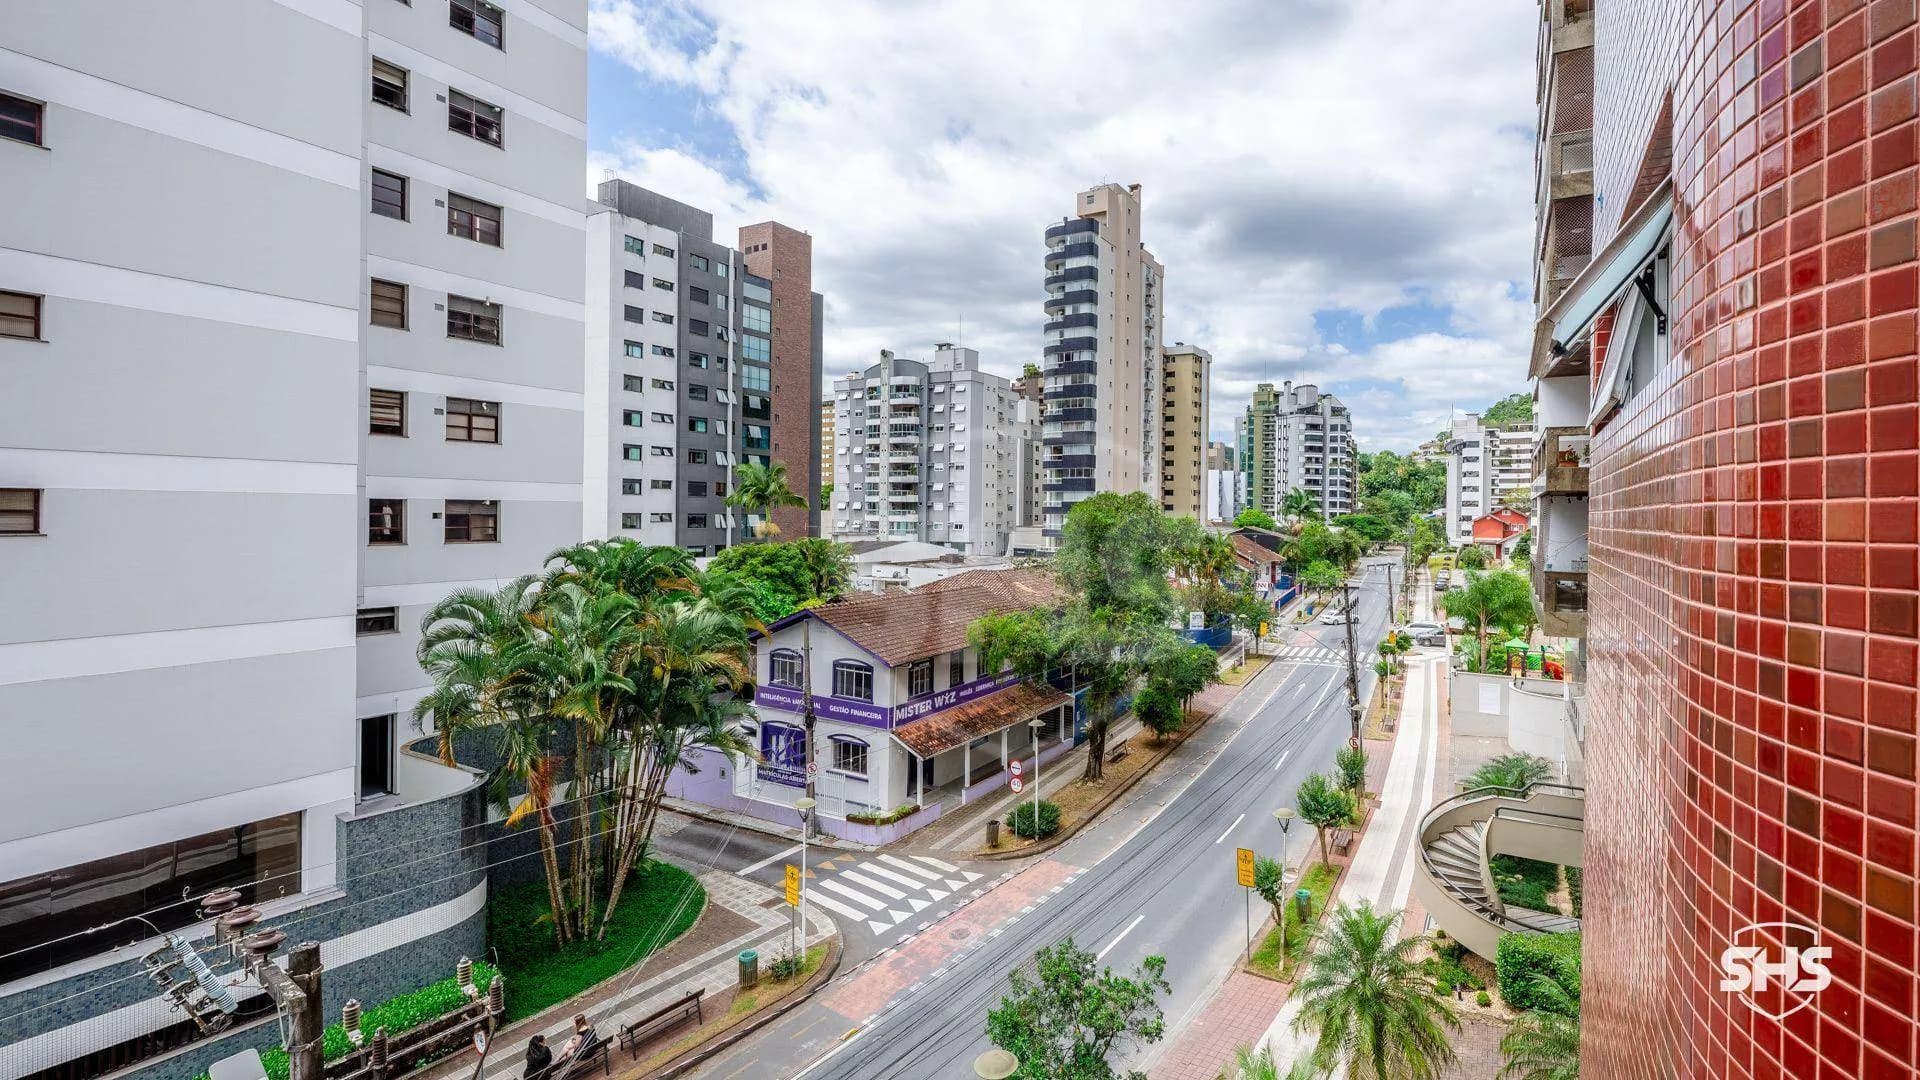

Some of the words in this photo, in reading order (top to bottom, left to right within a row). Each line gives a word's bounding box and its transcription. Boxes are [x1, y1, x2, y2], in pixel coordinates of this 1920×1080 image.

[760, 692, 791, 704] INTELIGÊNCIA
[829, 704, 850, 714] GESTÃO
[850, 709, 882, 720] FINANCEIRA
[895, 699, 932, 721] MISTER
